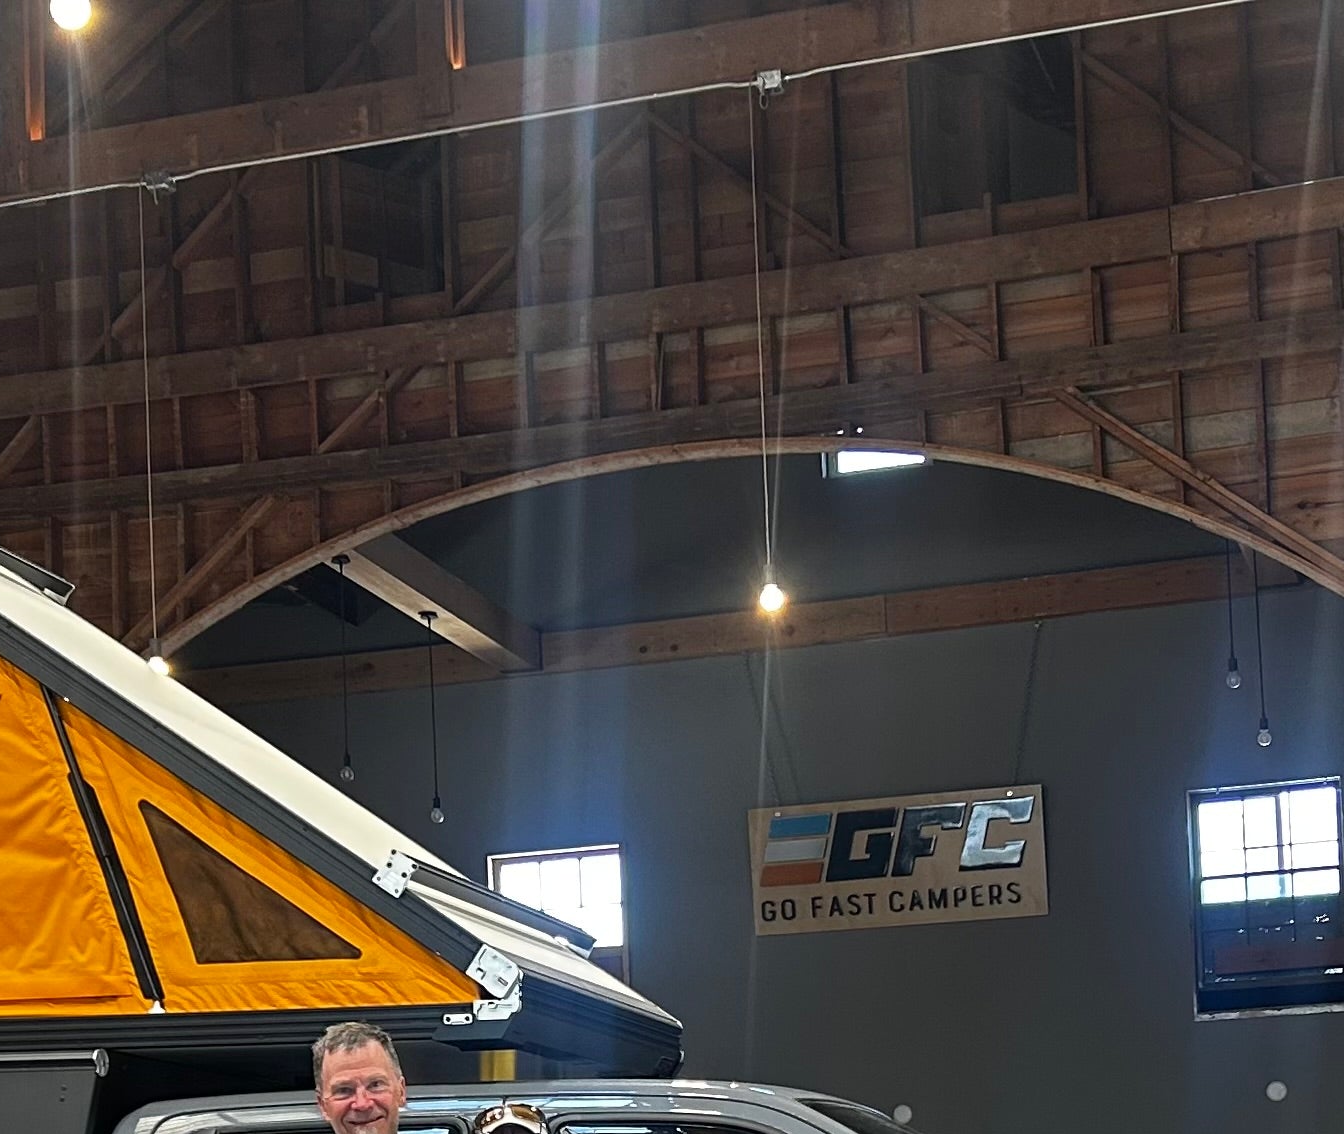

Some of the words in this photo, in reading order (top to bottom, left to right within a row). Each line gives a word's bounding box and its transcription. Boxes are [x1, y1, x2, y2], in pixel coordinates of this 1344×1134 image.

[825, 795, 1035, 883] GFC
[761, 898, 797, 923] GO
[811, 893, 877, 919] FAST
[888, 882, 1022, 914] CAMPERS
